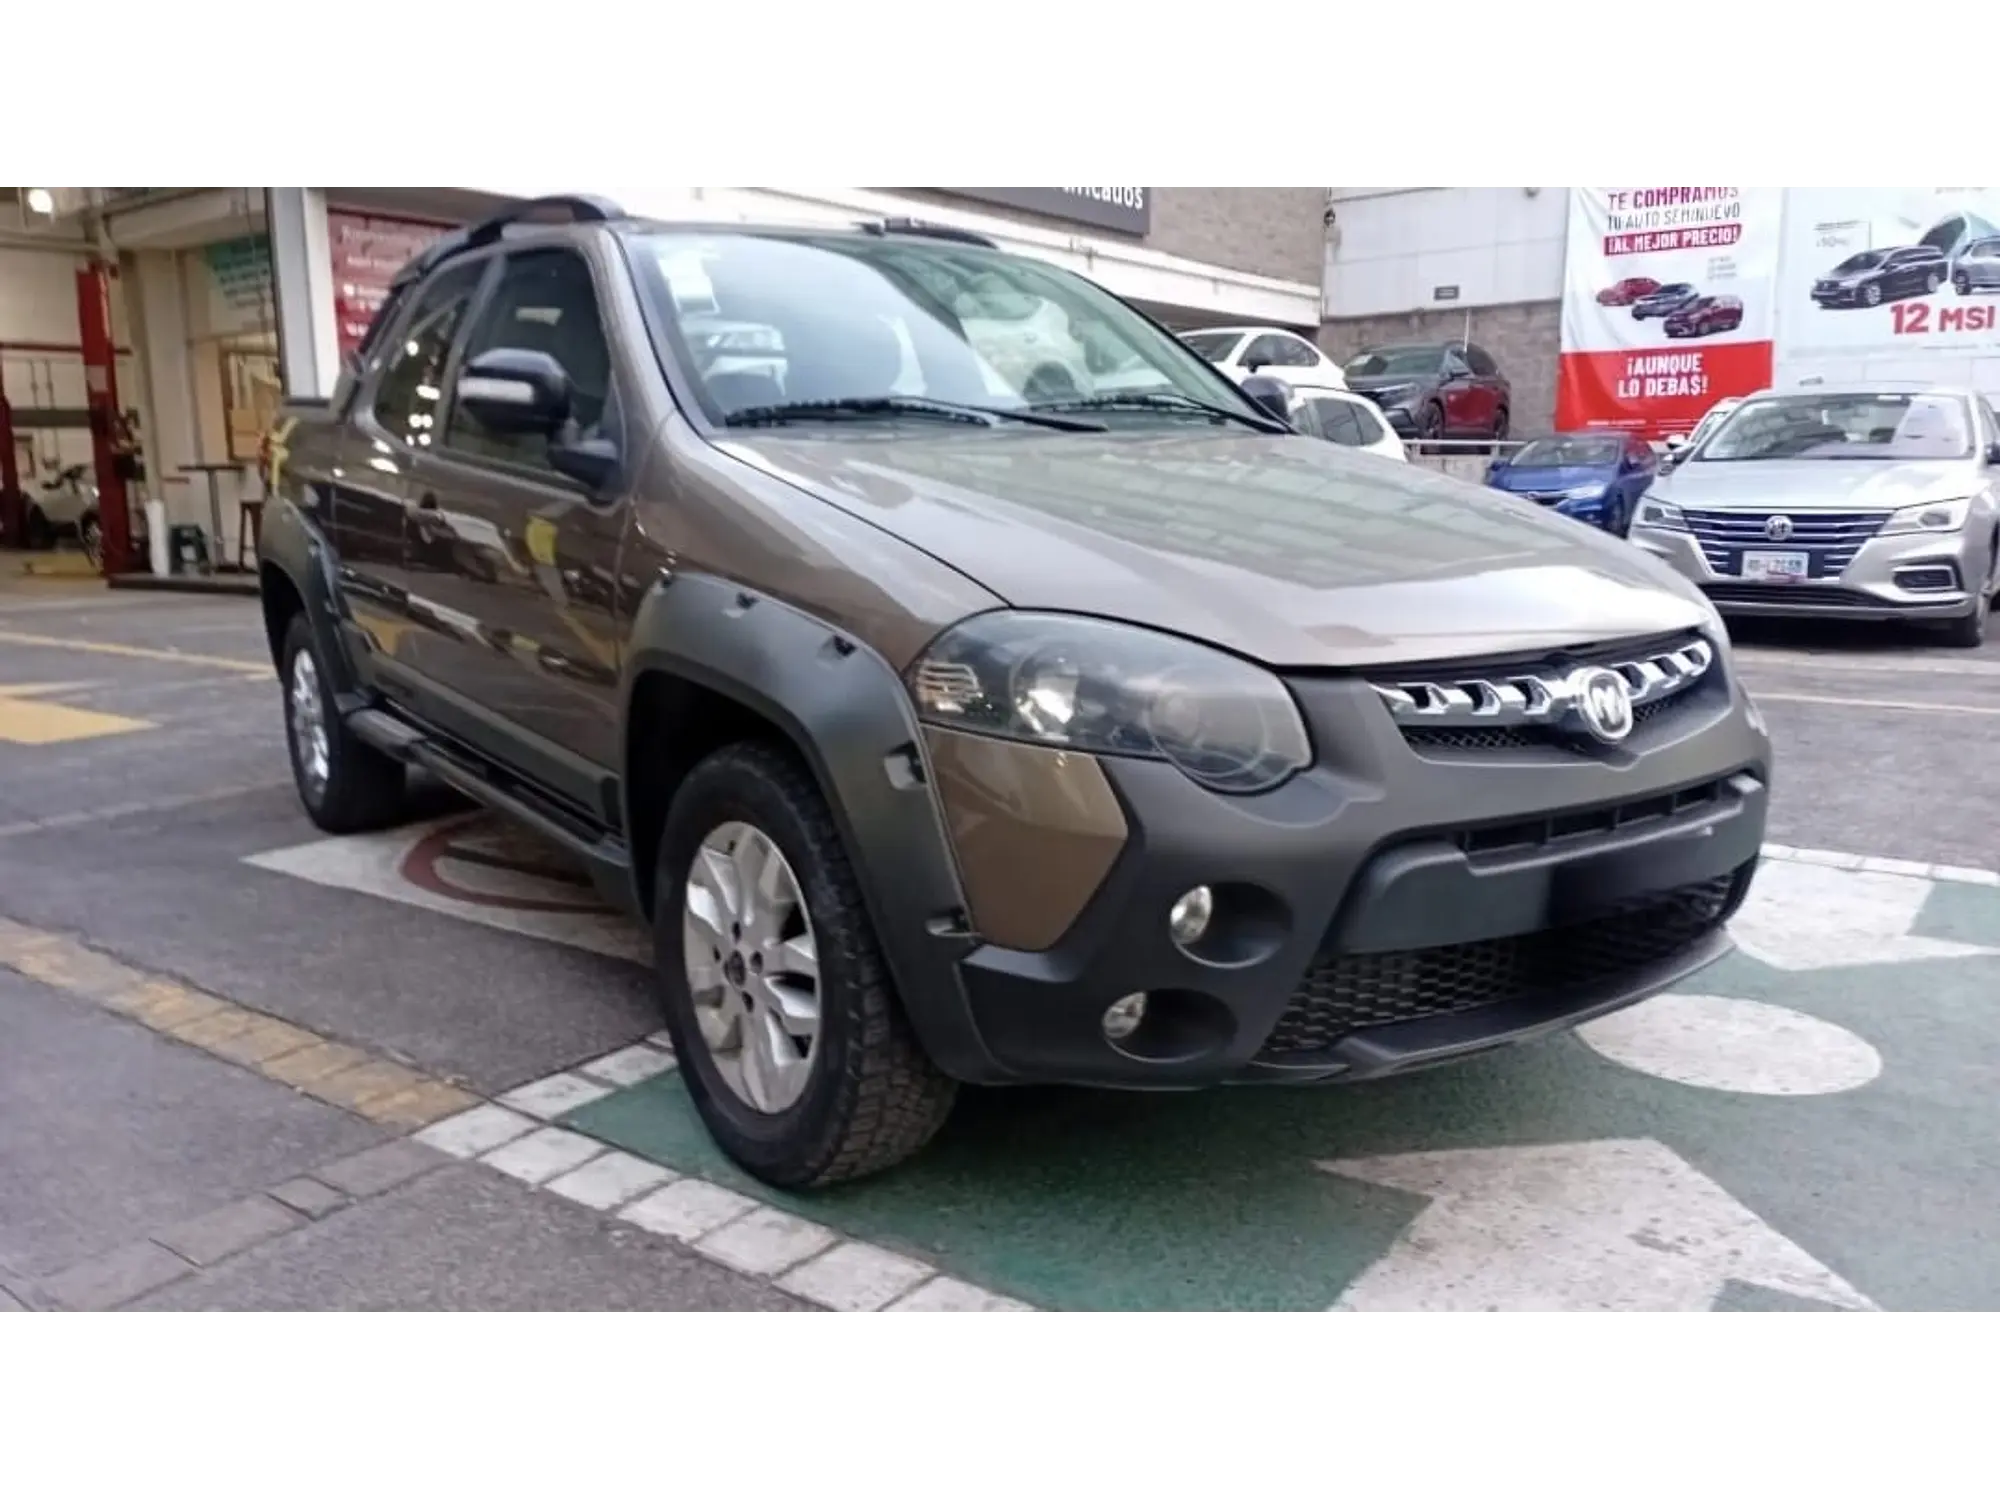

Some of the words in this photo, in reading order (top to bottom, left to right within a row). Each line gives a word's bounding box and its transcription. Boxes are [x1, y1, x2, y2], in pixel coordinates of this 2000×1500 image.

[1607, 192, 1628, 210] TE
[1633, 184, 1738, 209] COMPRAMOS
[1607, 214, 1621, 231] TU
[1625, 211, 1660, 229] AUTO
[1663, 201, 1740, 226] SEMINUEVO
[1608, 236, 1632, 254] ¡AL
[1634, 231, 1679, 252] MEJOR
[1682, 224, 1740, 247] PRECIO!
[1890, 303, 1930, 335] 12
[1938, 305, 1995, 332] MSI
[1627, 352, 1703, 377] ¡AUNQUE
[1618, 379, 1640, 397] LO
[1644, 373, 1708, 398] DEBAS!
